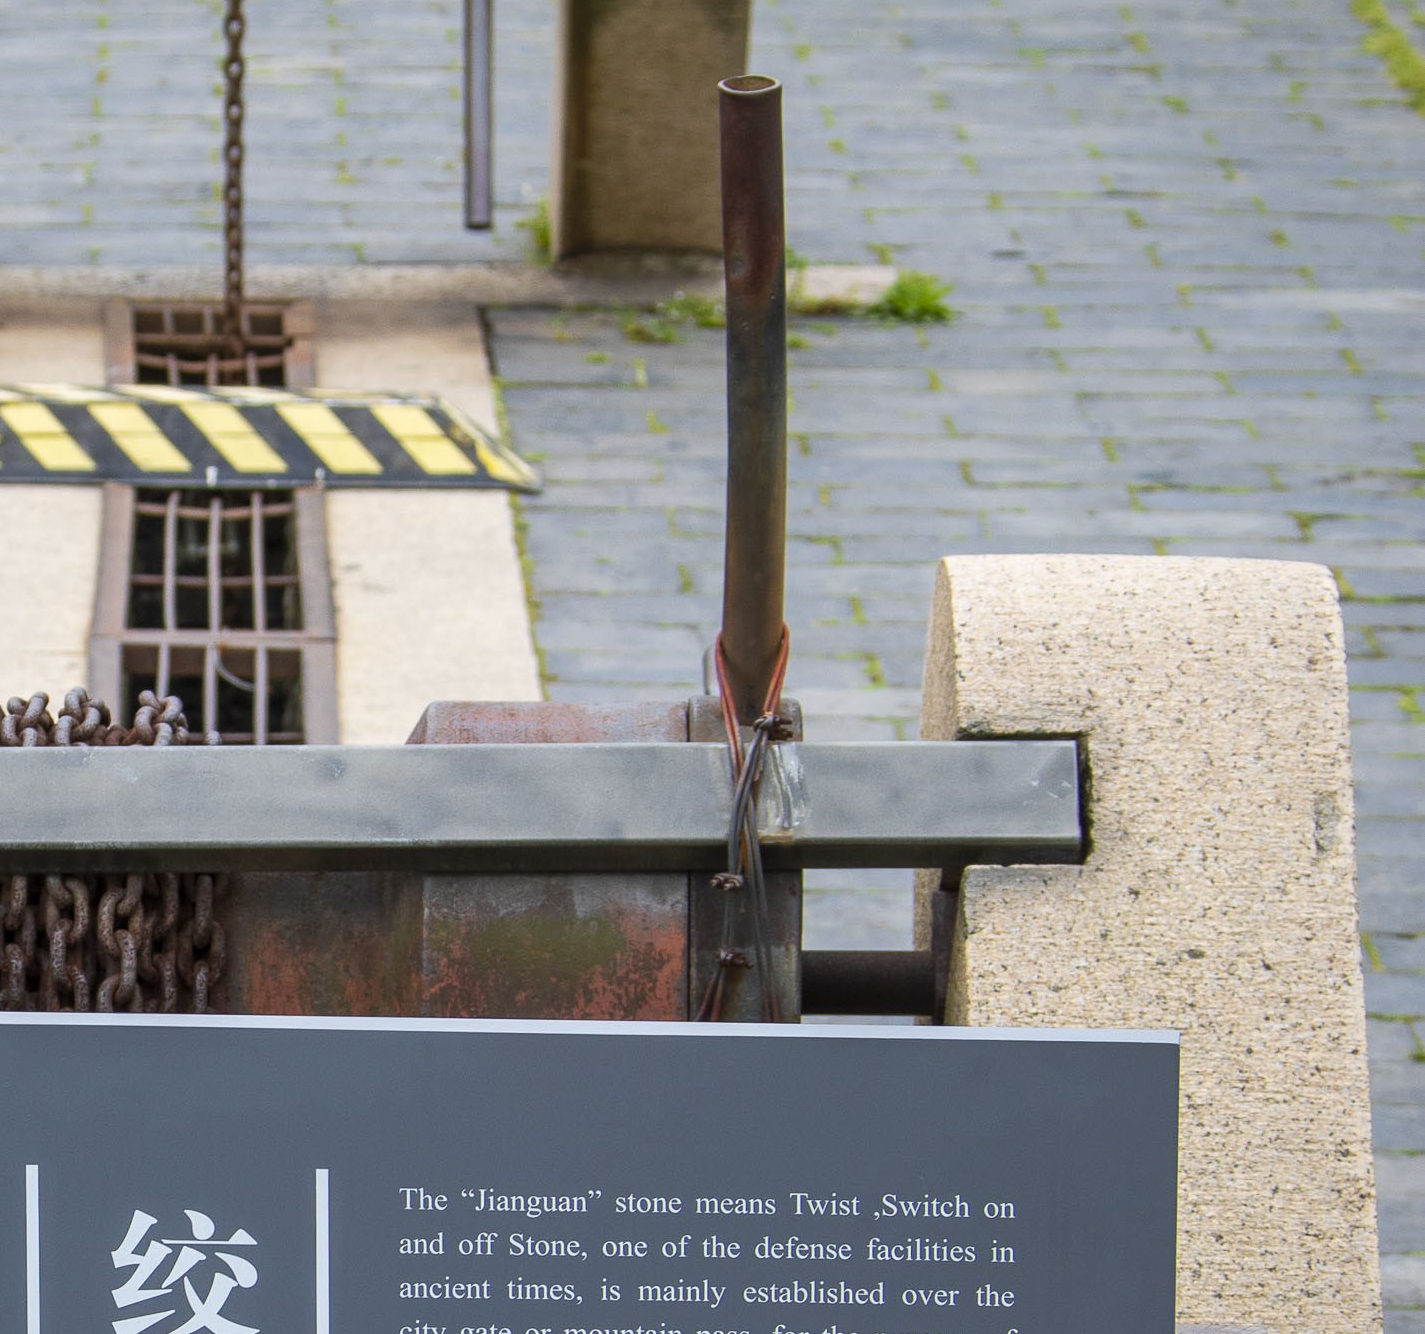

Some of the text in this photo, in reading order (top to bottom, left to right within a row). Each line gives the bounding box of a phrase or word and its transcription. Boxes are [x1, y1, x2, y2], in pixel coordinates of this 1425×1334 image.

[398, 1187, 448, 1211] The
[615, 1193, 682, 1214] stone
[695, 1197, 777, 1215] means
[789, 1192, 861, 1216] Twist
[983, 1202, 1016, 1219] on
[399, 1231, 1015, 1263] and off Stone, one of the defense facilities in
[399, 1275, 1015, 1309] ancient times, is mainly established over the
